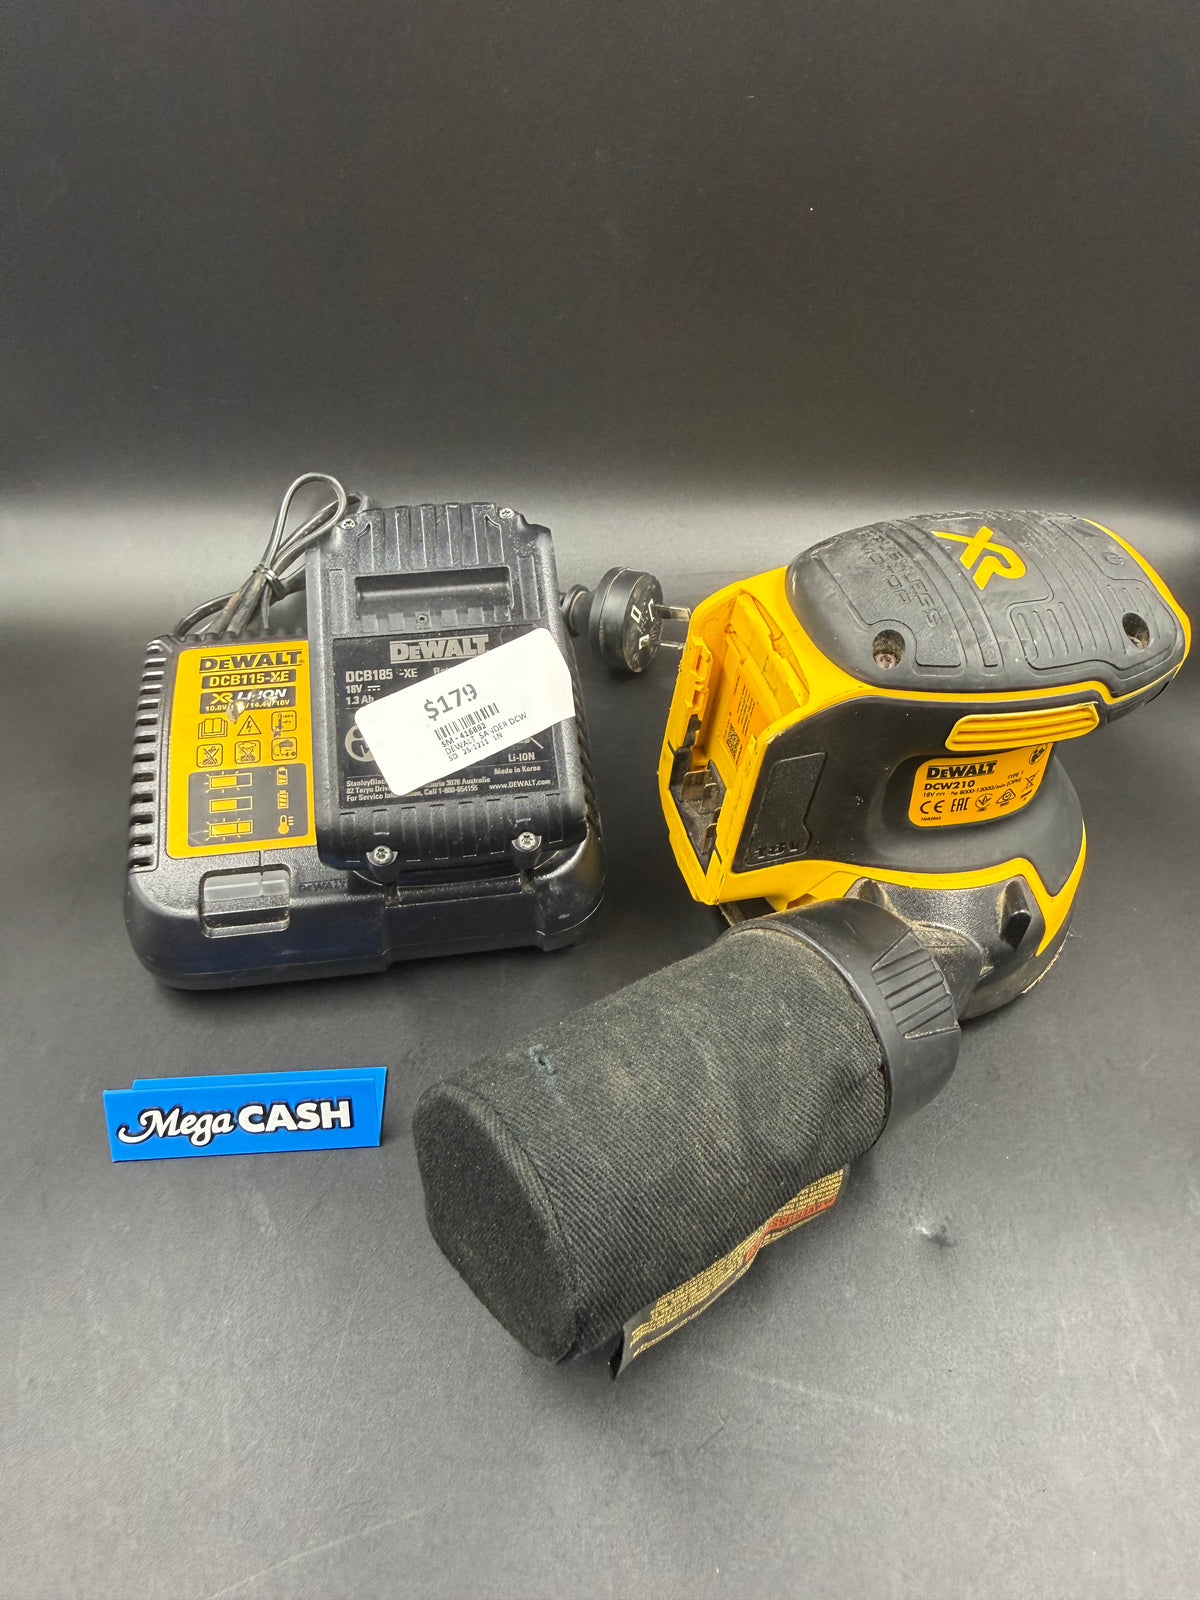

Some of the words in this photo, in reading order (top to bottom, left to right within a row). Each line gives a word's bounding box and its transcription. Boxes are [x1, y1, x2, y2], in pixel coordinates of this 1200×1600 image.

[209, 671, 289, 688] DCB115-XE
[345, 669, 393, 683] DCB185
[345, 684, 363, 694] 18V
[211, 692, 234, 705] XR
[345, 696, 361, 705] 1.3
[361, 695, 374, 704] Ah
[423, 683, 478, 722] $179
[445, 735, 477, 756] DEWALT
[508, 711, 528, 726] DCW
[448, 753, 459, 762] SD
[508, 752, 536, 763] Li-ION
[521, 765, 541, 773] Korea
[461, 776, 491, 785] Australia
[488, 779, 551, 790] www.DEWALT.com
[924, 779, 975, 791] DCW210
[346, 794, 358, 802] For
[358, 793, 384, 801] Service
[423, 788, 438, 796] Call
[117, 1106, 235, 1147] Mega
[237, 1100, 352, 1134] CASH
